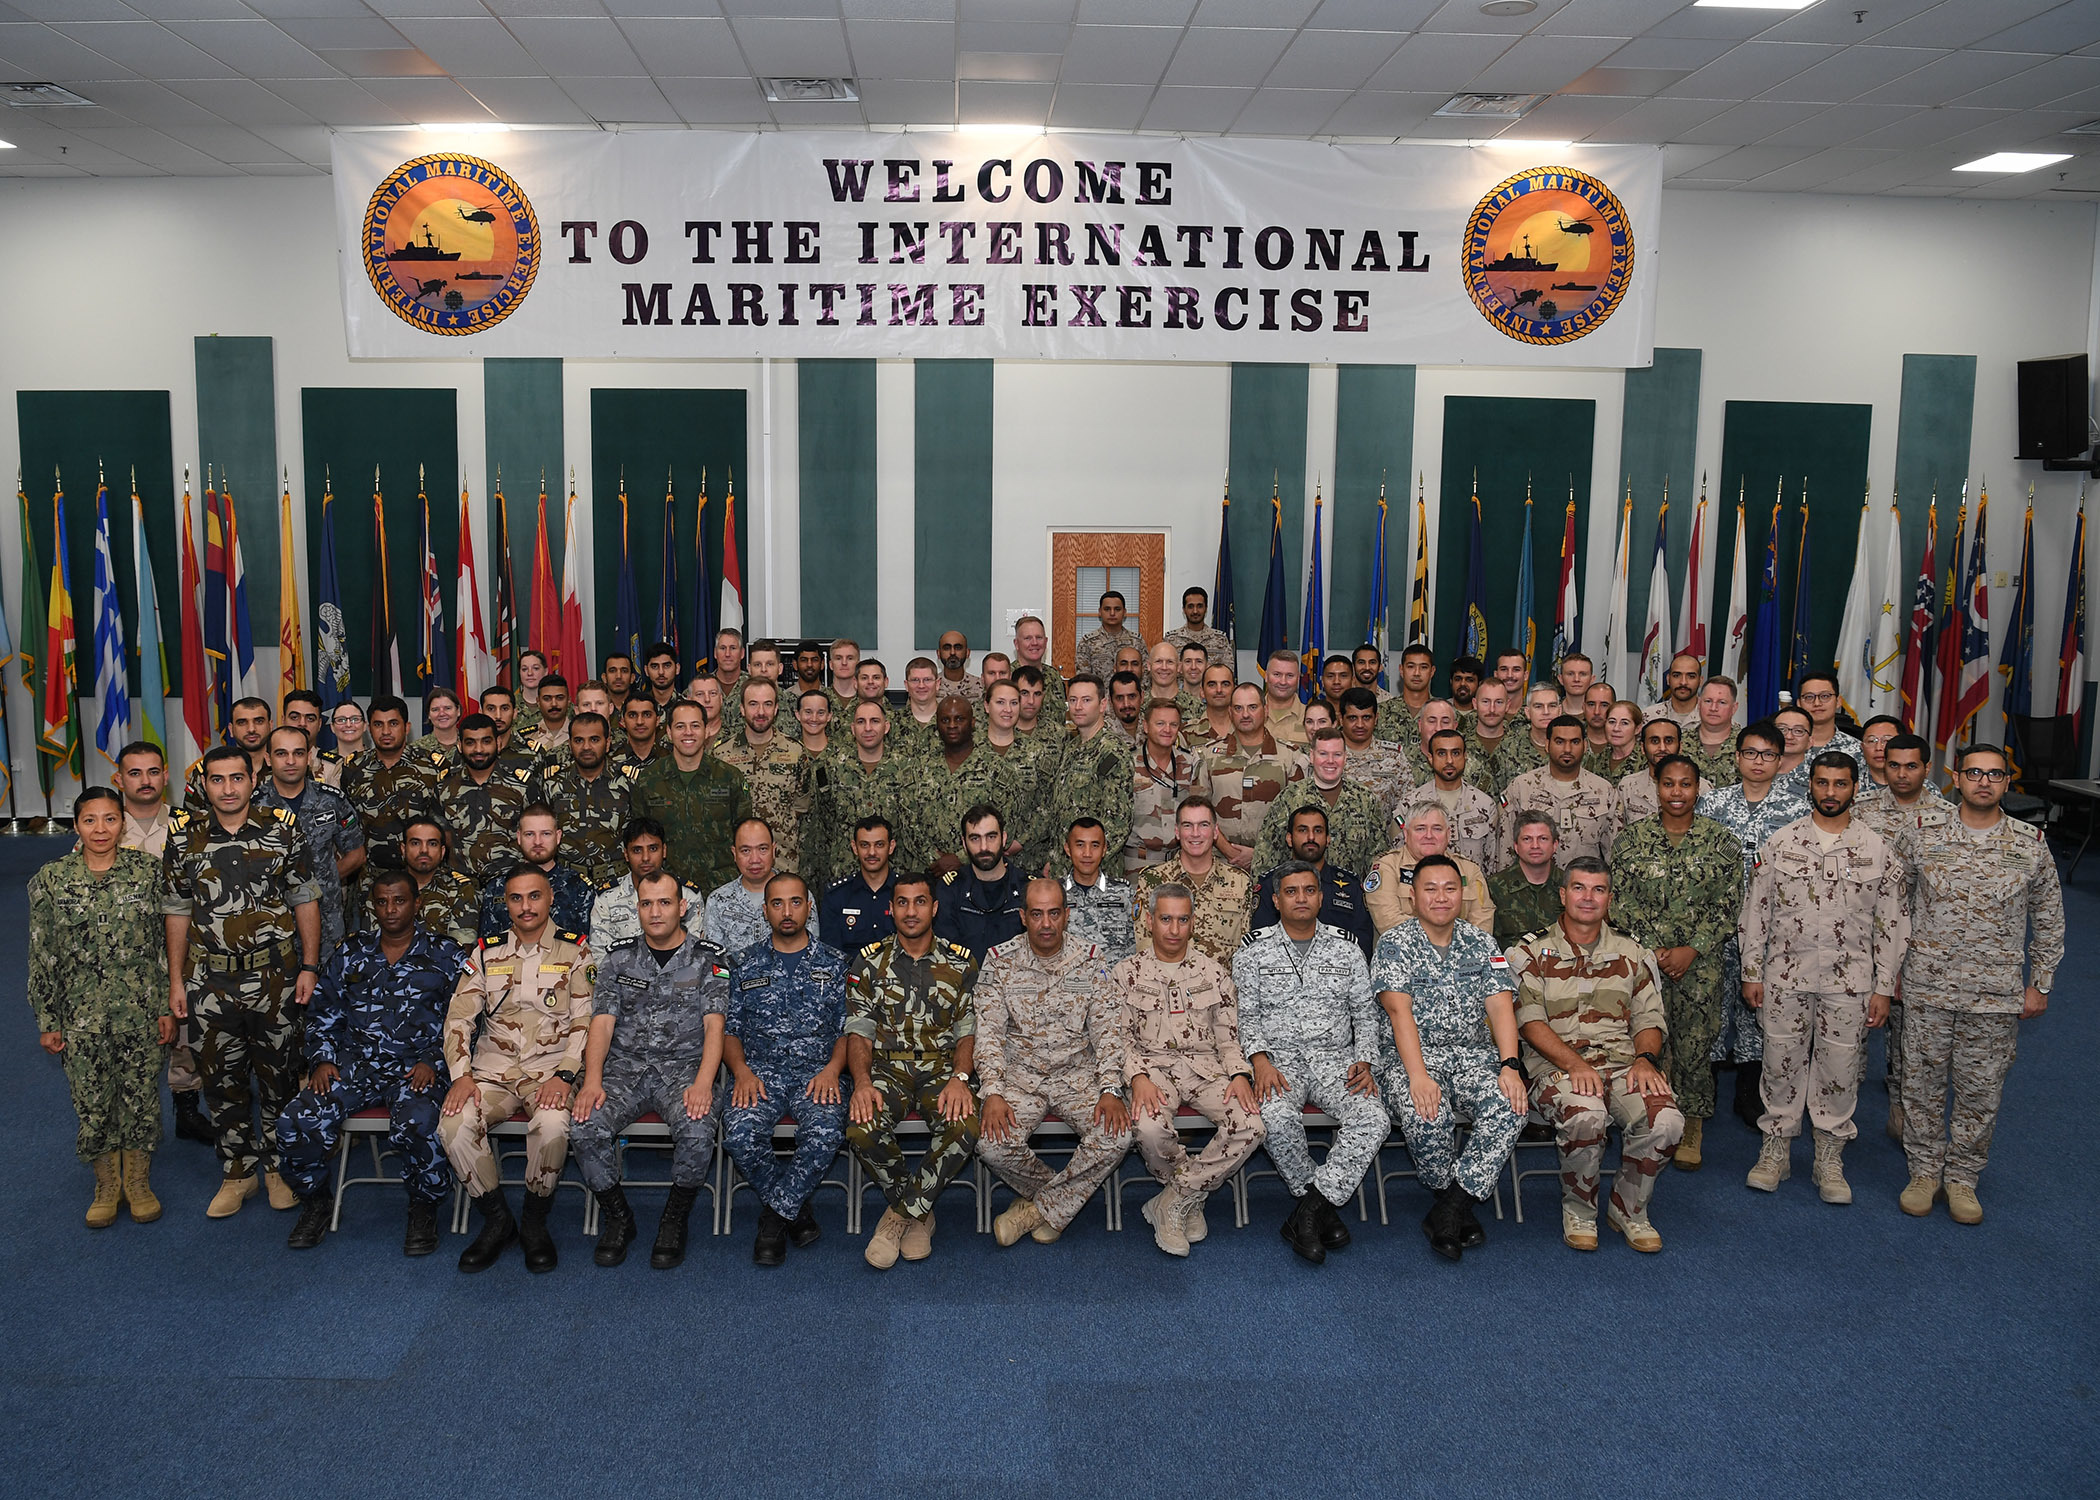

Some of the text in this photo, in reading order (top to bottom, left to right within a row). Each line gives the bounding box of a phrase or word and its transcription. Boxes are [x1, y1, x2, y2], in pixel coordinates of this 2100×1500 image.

[823, 159, 1171, 206] WELCOME
[371, 161, 532, 324] INTERNATIONAL MARITIME EXERCISE
[561, 220, 1430, 274] TO THE INTERNATIONAL
[1471, 175, 1626, 335] INTERNATIONAL MARITIME EXERCISE
[622, 283, 1369, 334] MARITIME EXERCISE
[1478, 621, 1486, 650] SEAL
